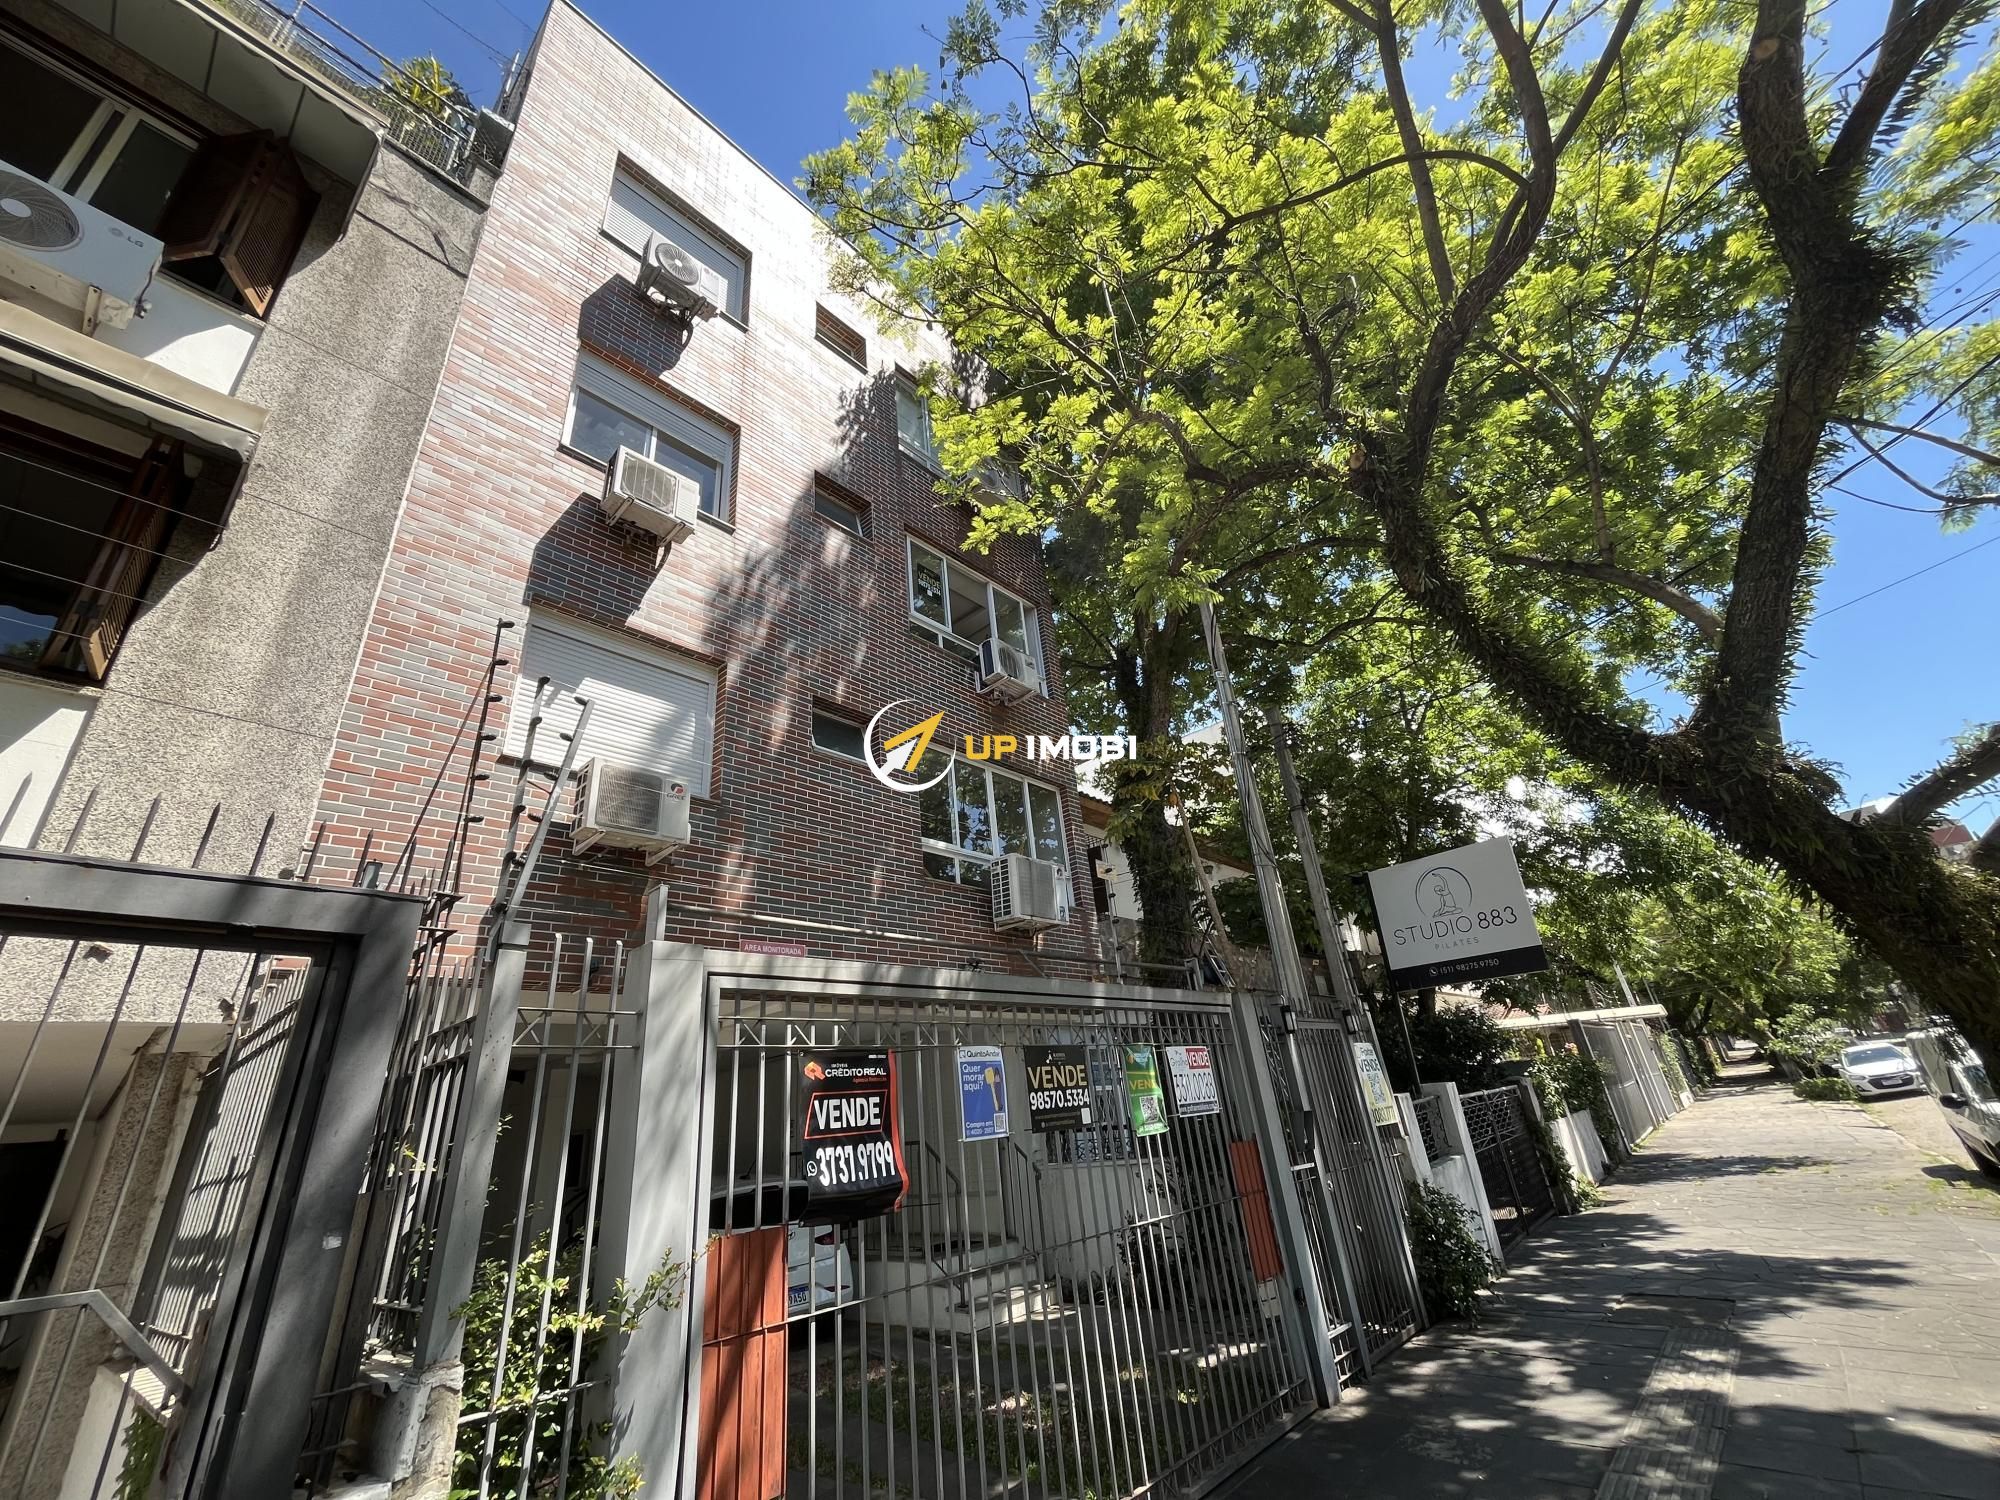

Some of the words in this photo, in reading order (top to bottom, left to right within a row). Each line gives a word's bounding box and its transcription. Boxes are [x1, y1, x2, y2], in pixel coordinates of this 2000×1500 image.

[127, 236, 144, 247] LG
[1394, 916, 1472, 945] STUDIO
[1477, 906, 1517, 929] 883
[1435, 937, 1479, 950] PILATES
[1440, 967, 1454, 975] (51)
[1187, 1051, 1209, 1067] VENDE
[863, 1067, 887, 1076] REAL
[962, 1063, 981, 1073] Quer
[963, 1073, 985, 1082] morar
[1027, 1064, 1088, 1089] VENDE
[963, 1081, 984, 1092] aqui?
[1029, 1088, 1090, 1110] 98570.5334
[813, 1096, 881, 1130] VENDE
[816, 1140, 896, 1187] 3737.9799
